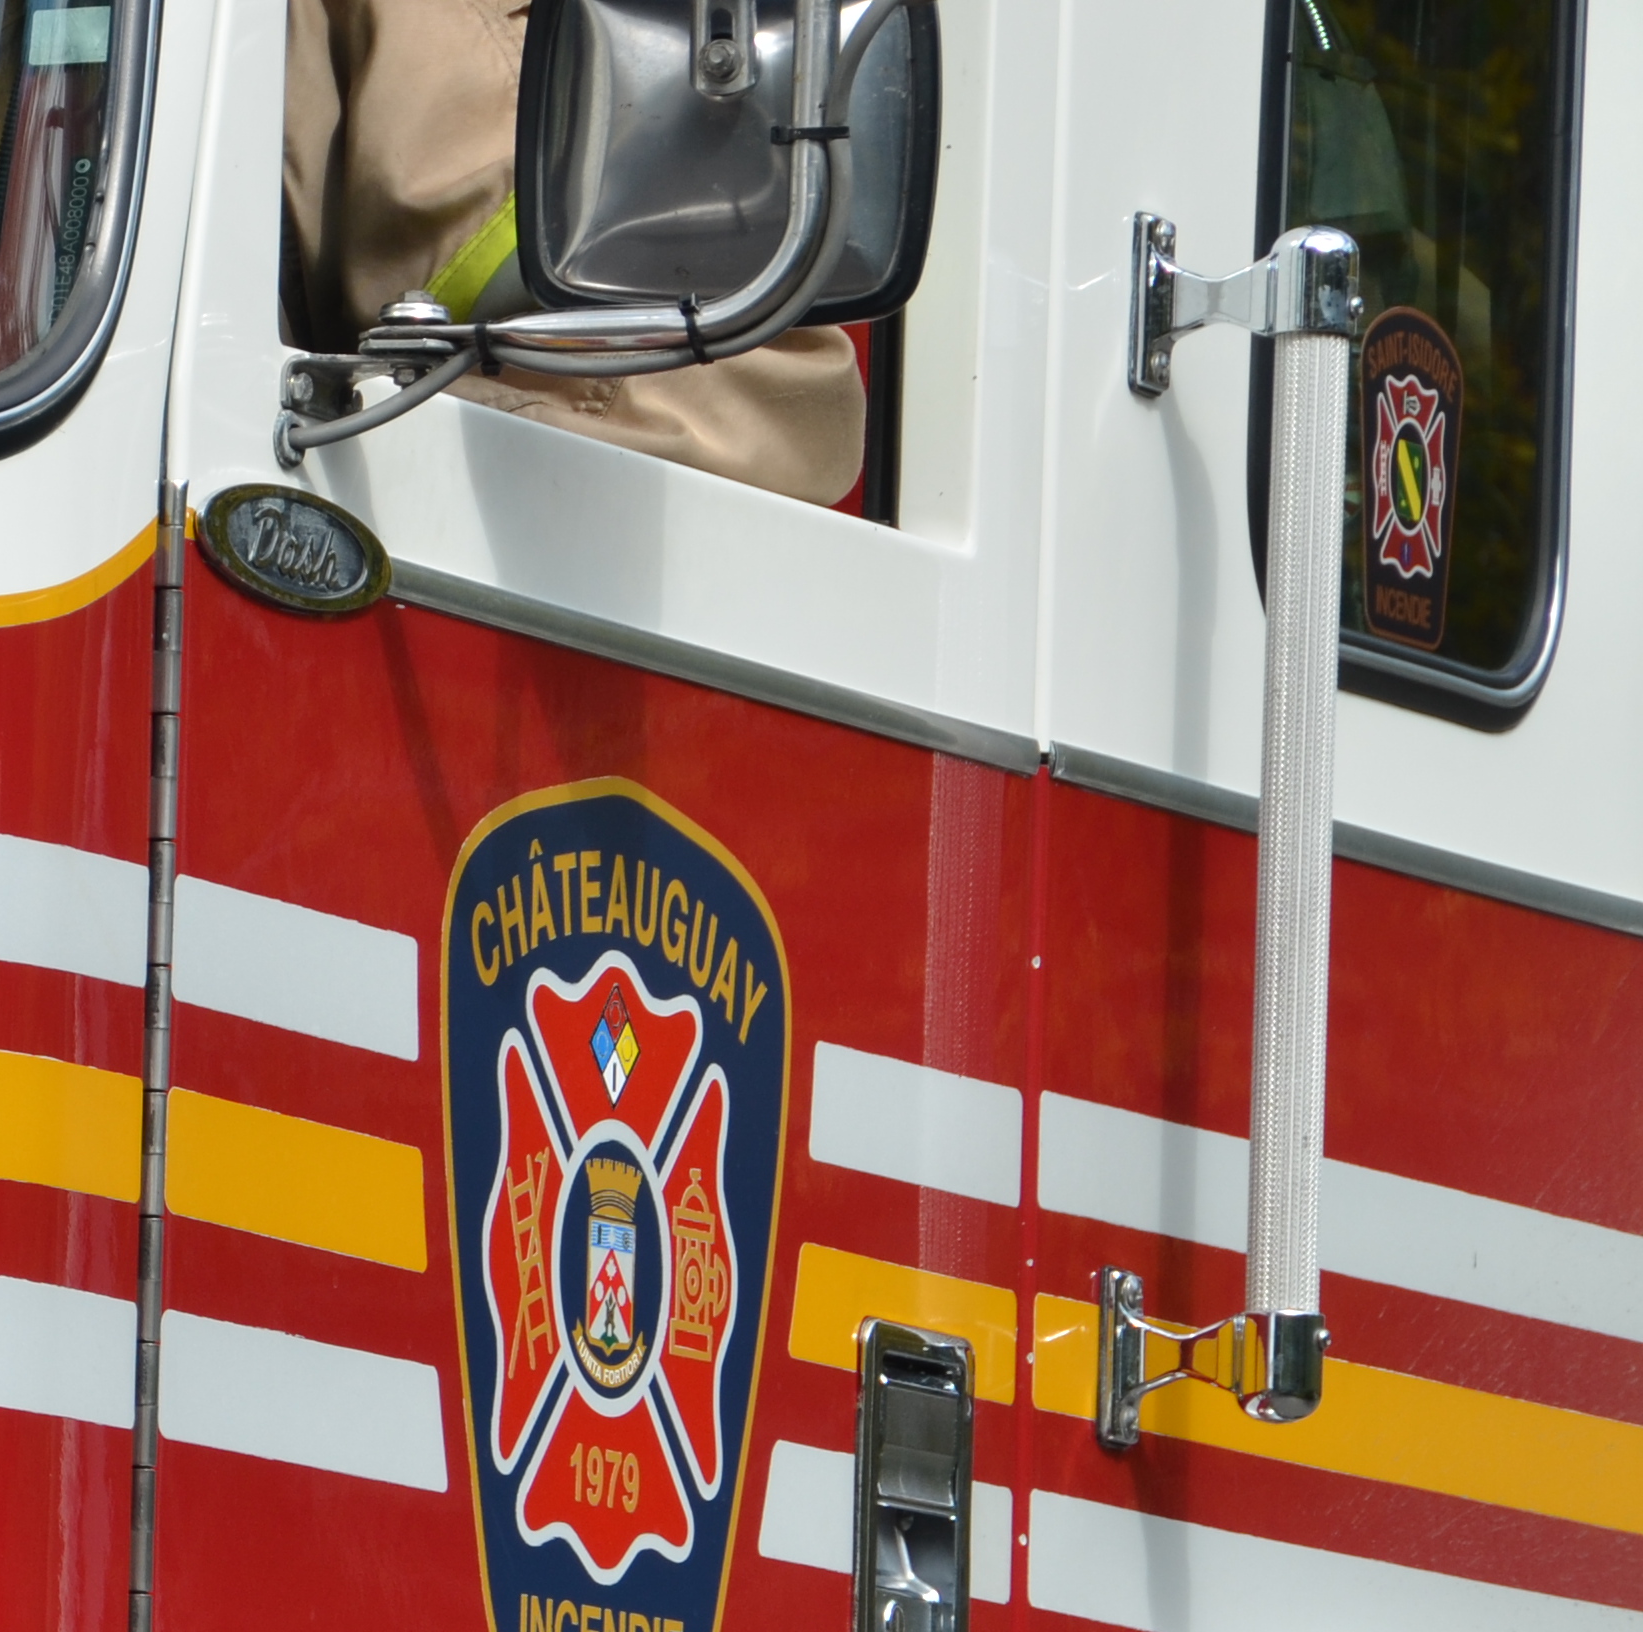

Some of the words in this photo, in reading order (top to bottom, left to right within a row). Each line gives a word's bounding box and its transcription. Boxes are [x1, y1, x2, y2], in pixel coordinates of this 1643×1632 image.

[1368, 330, 1457, 403] SAINT-ISIDORE
[248, 504, 349, 590] Dash
[1376, 584, 1432, 630] INCENDIE
[471, 838, 768, 1046] CHÂTEAUGUAY
[570, 1443, 640, 1514] 1979
